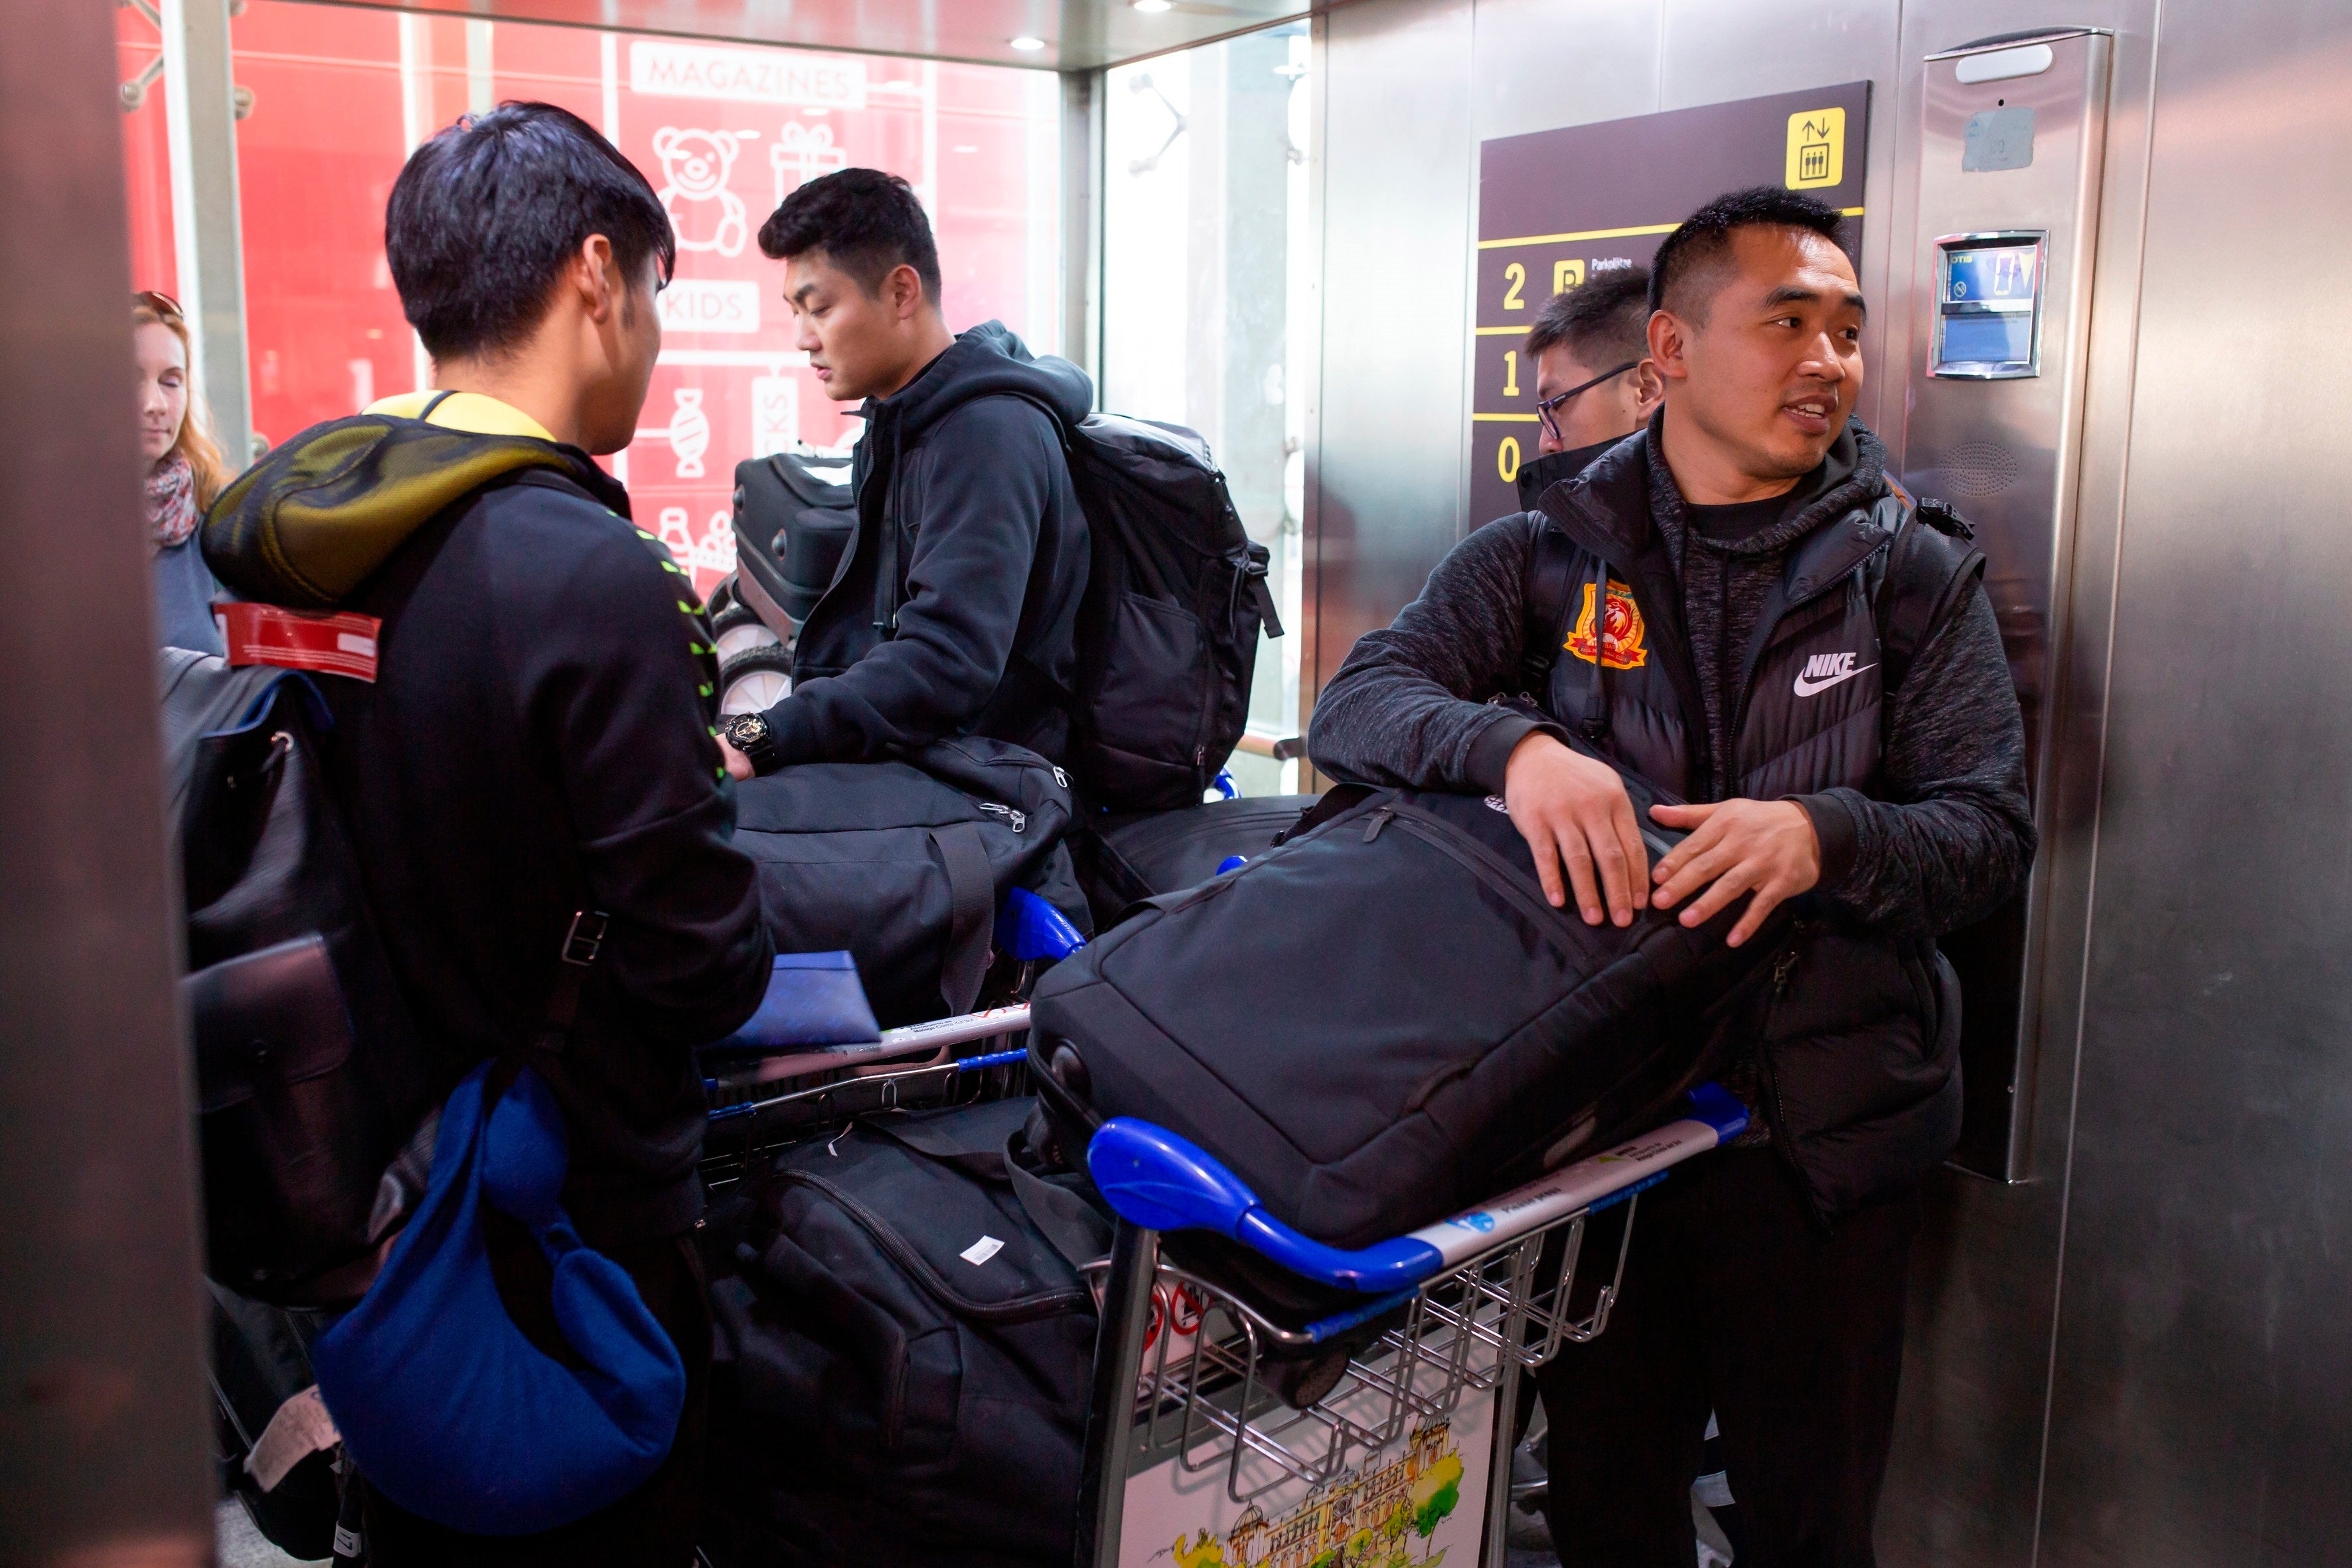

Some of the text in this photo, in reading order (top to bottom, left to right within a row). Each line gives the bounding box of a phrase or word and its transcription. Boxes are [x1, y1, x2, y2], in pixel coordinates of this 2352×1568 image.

[649, 58, 850, 99] MAGAZINES
[1950, 255, 1973, 264] OTIS
[1993, 252, 2015, 296] 0
[665, 291, 743, 321] KIDS
[1504, 262, 1526, 310] 2
[1503, 351, 1520, 397] 1
[1498, 436, 1520, 483] 0
[1804, 653, 1857, 677] NIKE
